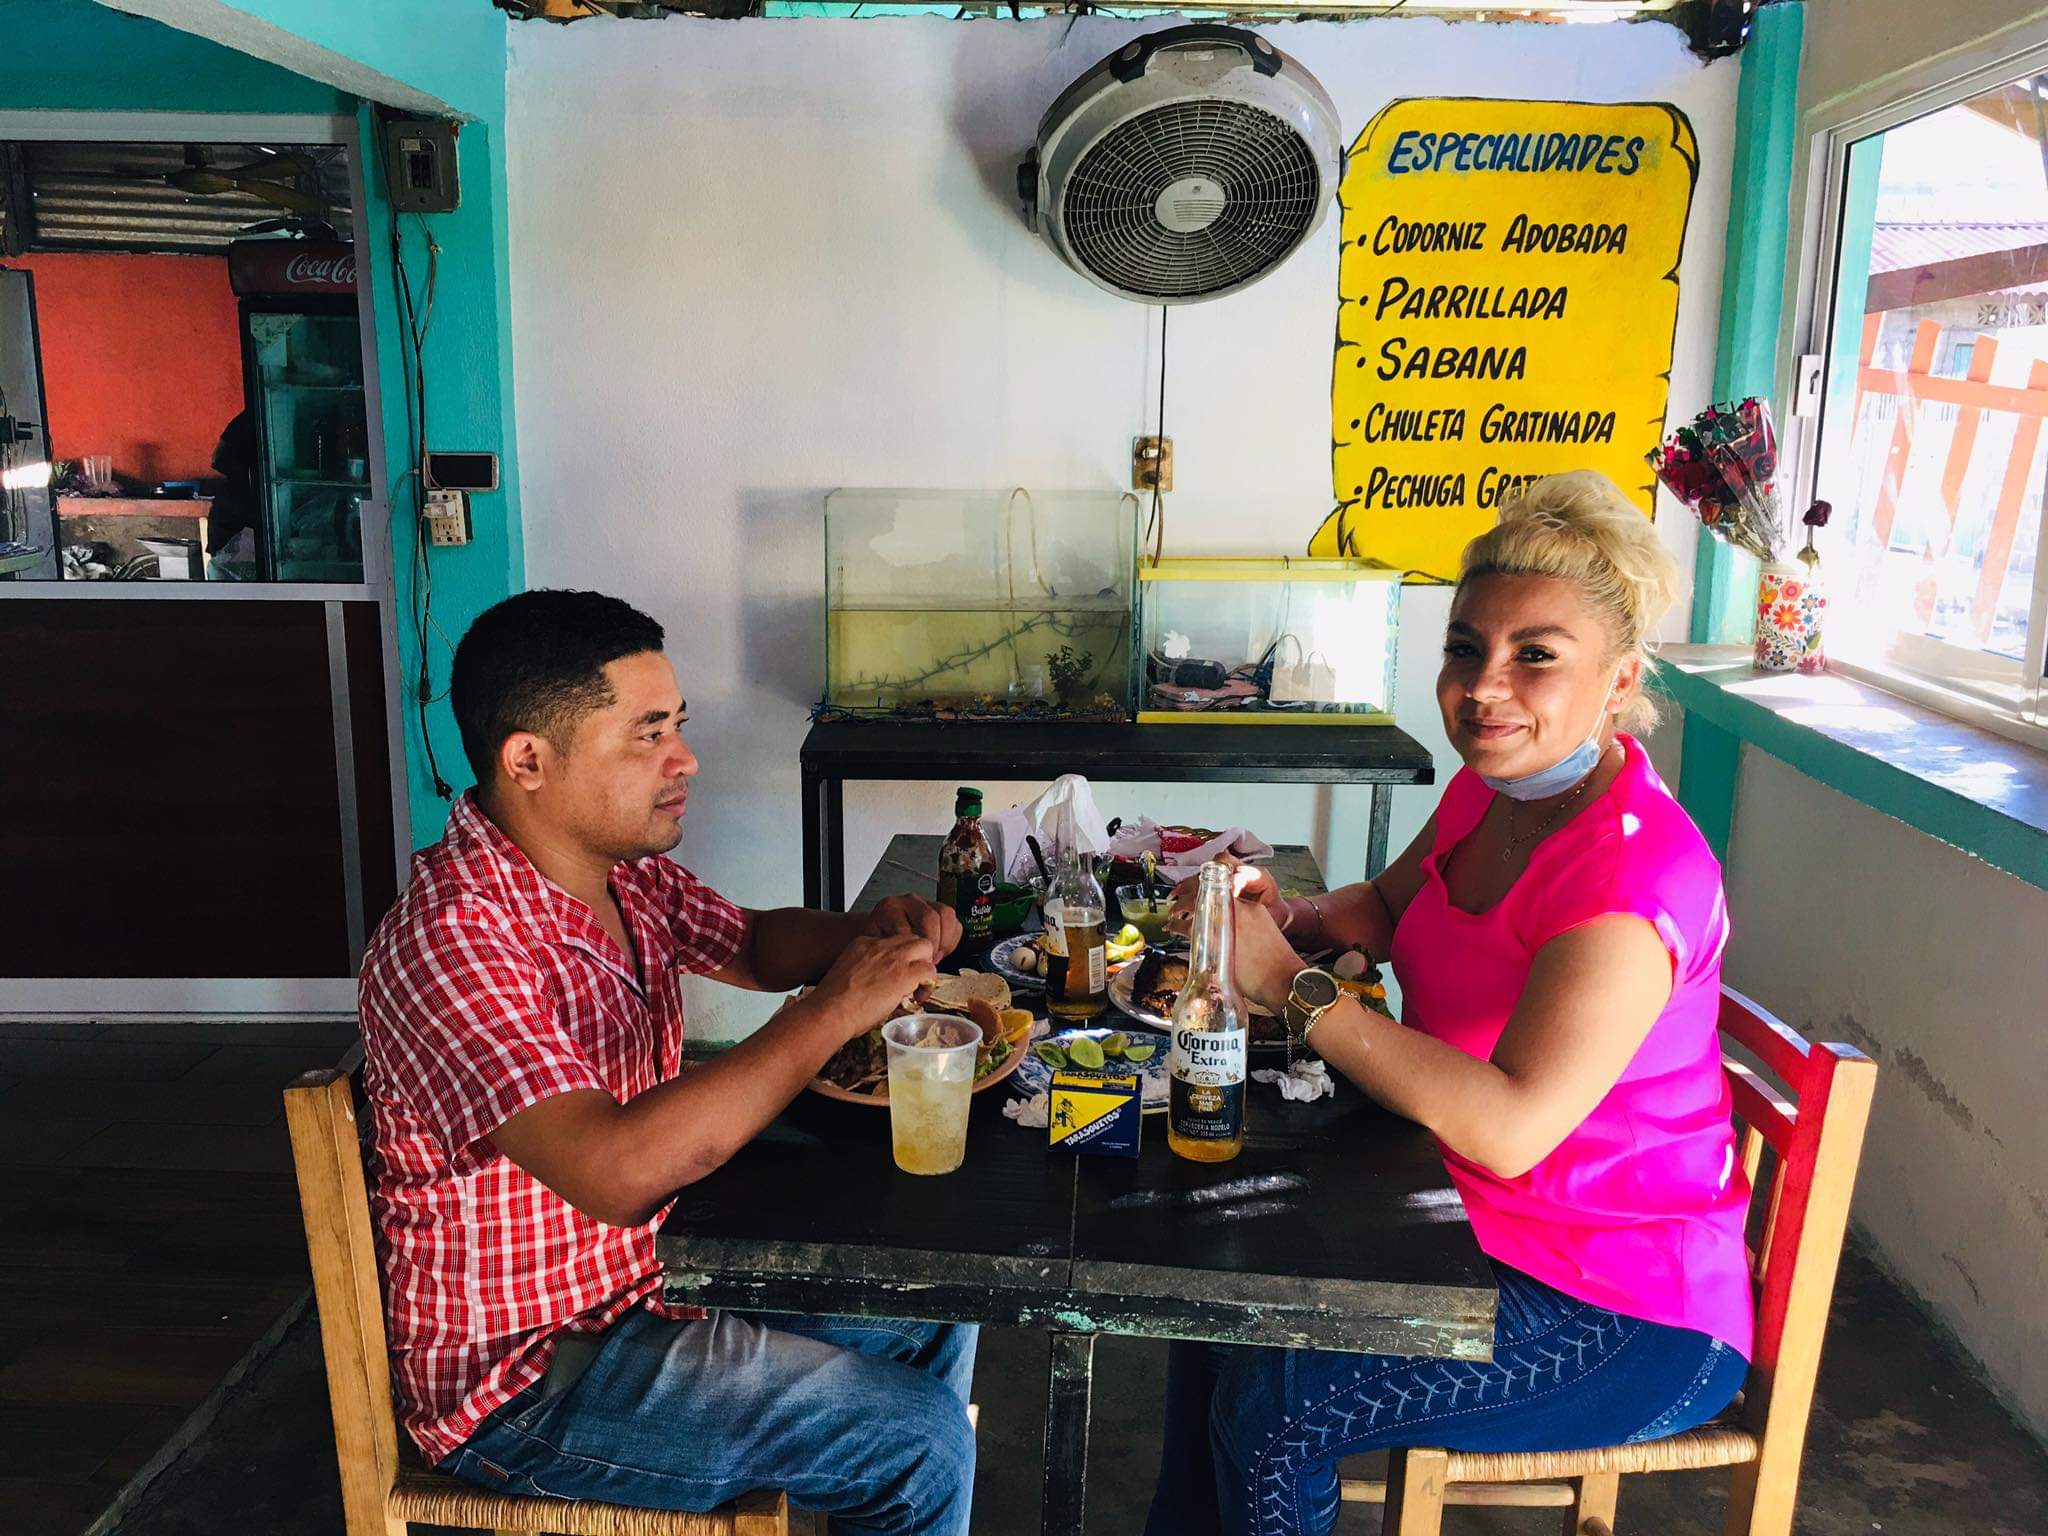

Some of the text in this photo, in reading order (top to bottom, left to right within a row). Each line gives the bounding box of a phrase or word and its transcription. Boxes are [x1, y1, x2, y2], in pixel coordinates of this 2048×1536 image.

[1388, 130, 1645, 175] ESPECIALIDADES
[1373, 213, 1628, 257] CODORNIZ ADOBADA
[1376, 276, 1568, 321] PARRILLADA
[1377, 337, 1527, 381] SABANA
[1365, 402, 1616, 443] CHULETA GRATINADA
[1364, 466, 1465, 510] PECHUGA
[1177, 1030, 1239, 1054] Corona
[1191, 1051, 1228, 1066] Extra
